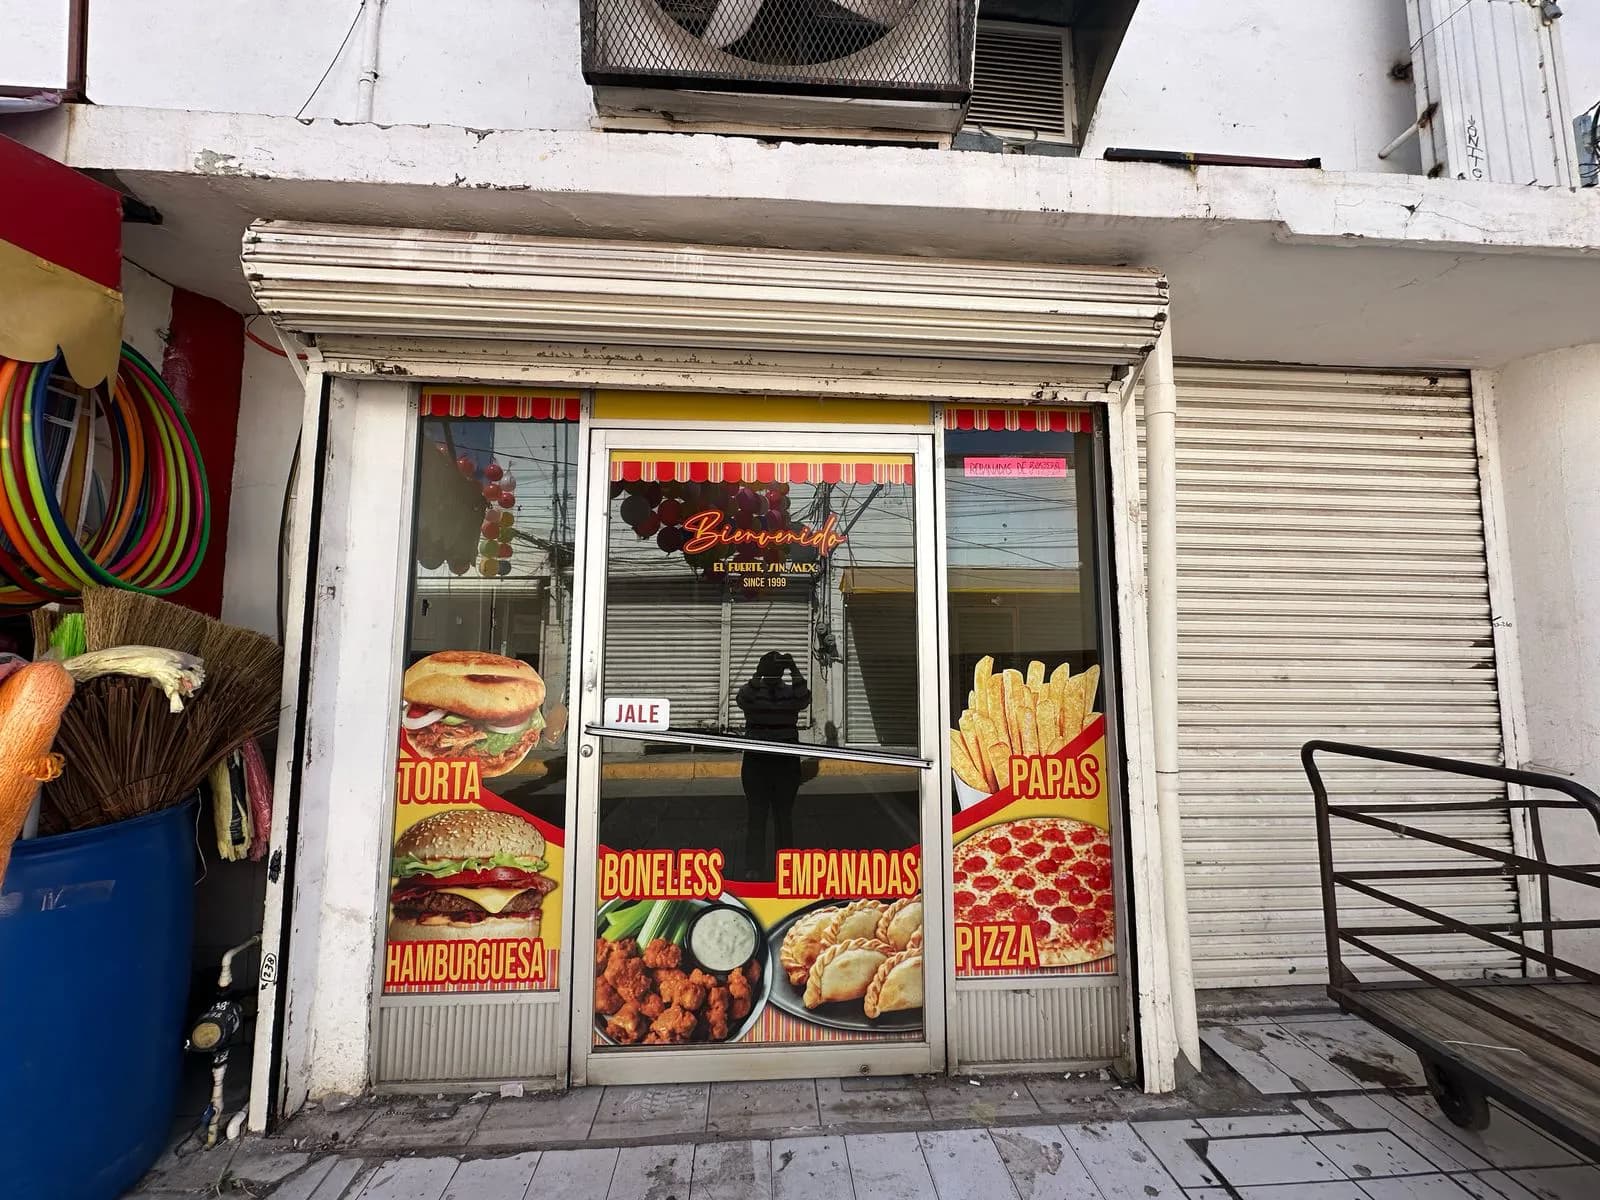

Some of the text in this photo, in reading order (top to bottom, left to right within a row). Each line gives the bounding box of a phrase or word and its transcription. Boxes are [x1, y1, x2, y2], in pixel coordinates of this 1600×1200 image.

[683, 509, 848, 556] Bienvenido
[713, 562, 725, 573] EL
[743, 577, 787, 588] SINCE 1999
[615, 704, 660, 723] JALE
[398, 760, 482, 802] TORTA
[1011, 757, 1098, 797] PAPAS
[602, 851, 724, 897] BONELESS
[777, 851, 917, 896] EMPANADAS
[263, 956, 275, 978] 238
[384, 940, 545, 983] HAMBURGUESA
[955, 924, 1038, 968] PIZZA
